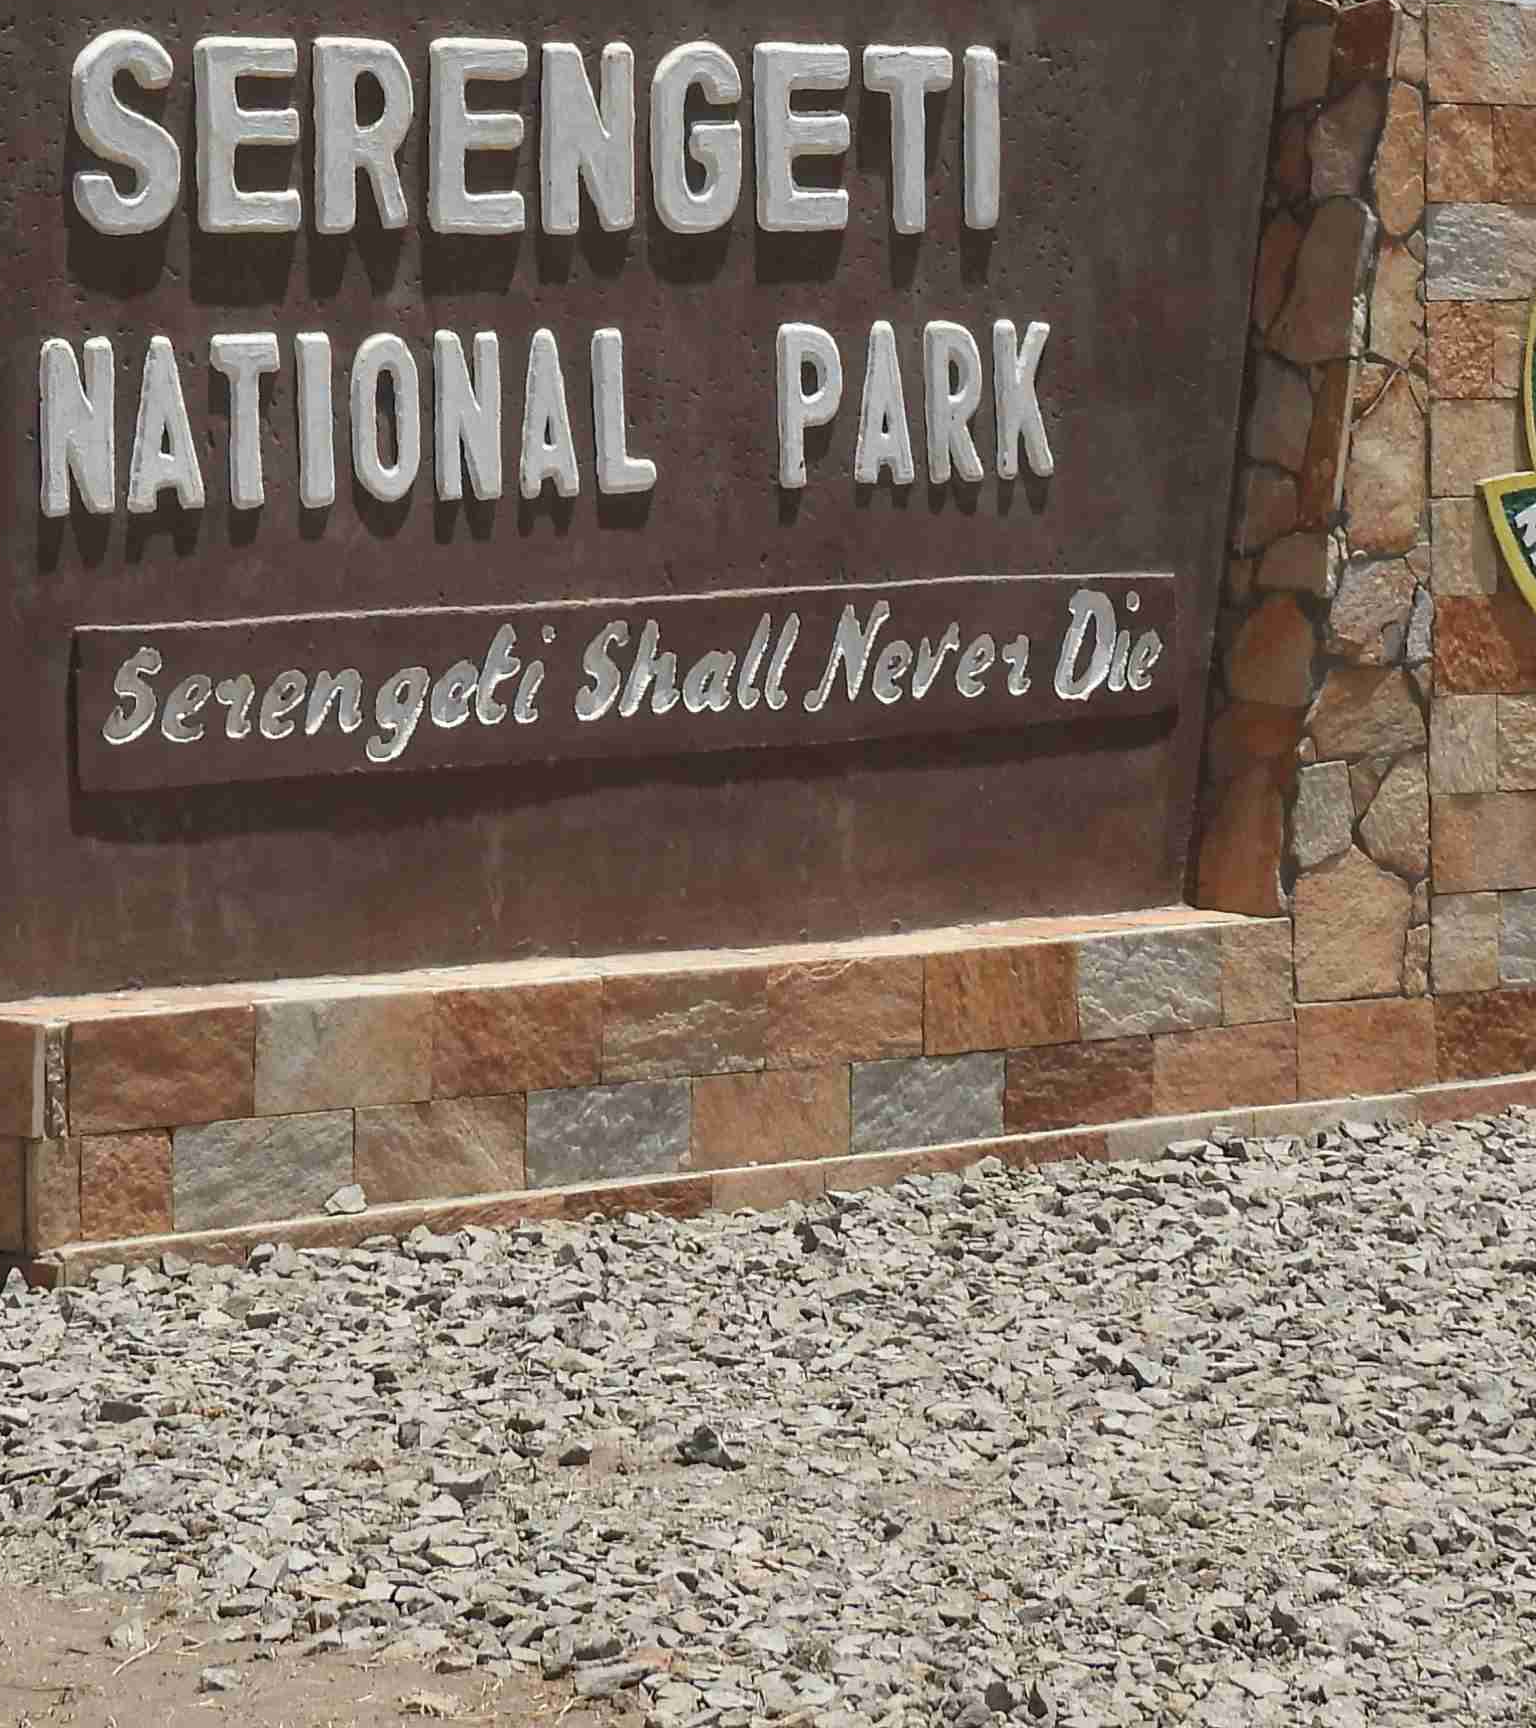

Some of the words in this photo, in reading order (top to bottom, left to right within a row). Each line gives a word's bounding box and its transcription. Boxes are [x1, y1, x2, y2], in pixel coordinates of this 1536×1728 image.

[72, 29, 1000, 234] SERENGETI
[39, 327, 657, 516] NATIONAL
[776, 320, 1054, 488] PARK
[102, 622, 558, 762] Serengeti
[575, 611, 800, 723] Shall
[804, 599, 1033, 713] Never
[1054, 589, 1160, 702] Die
